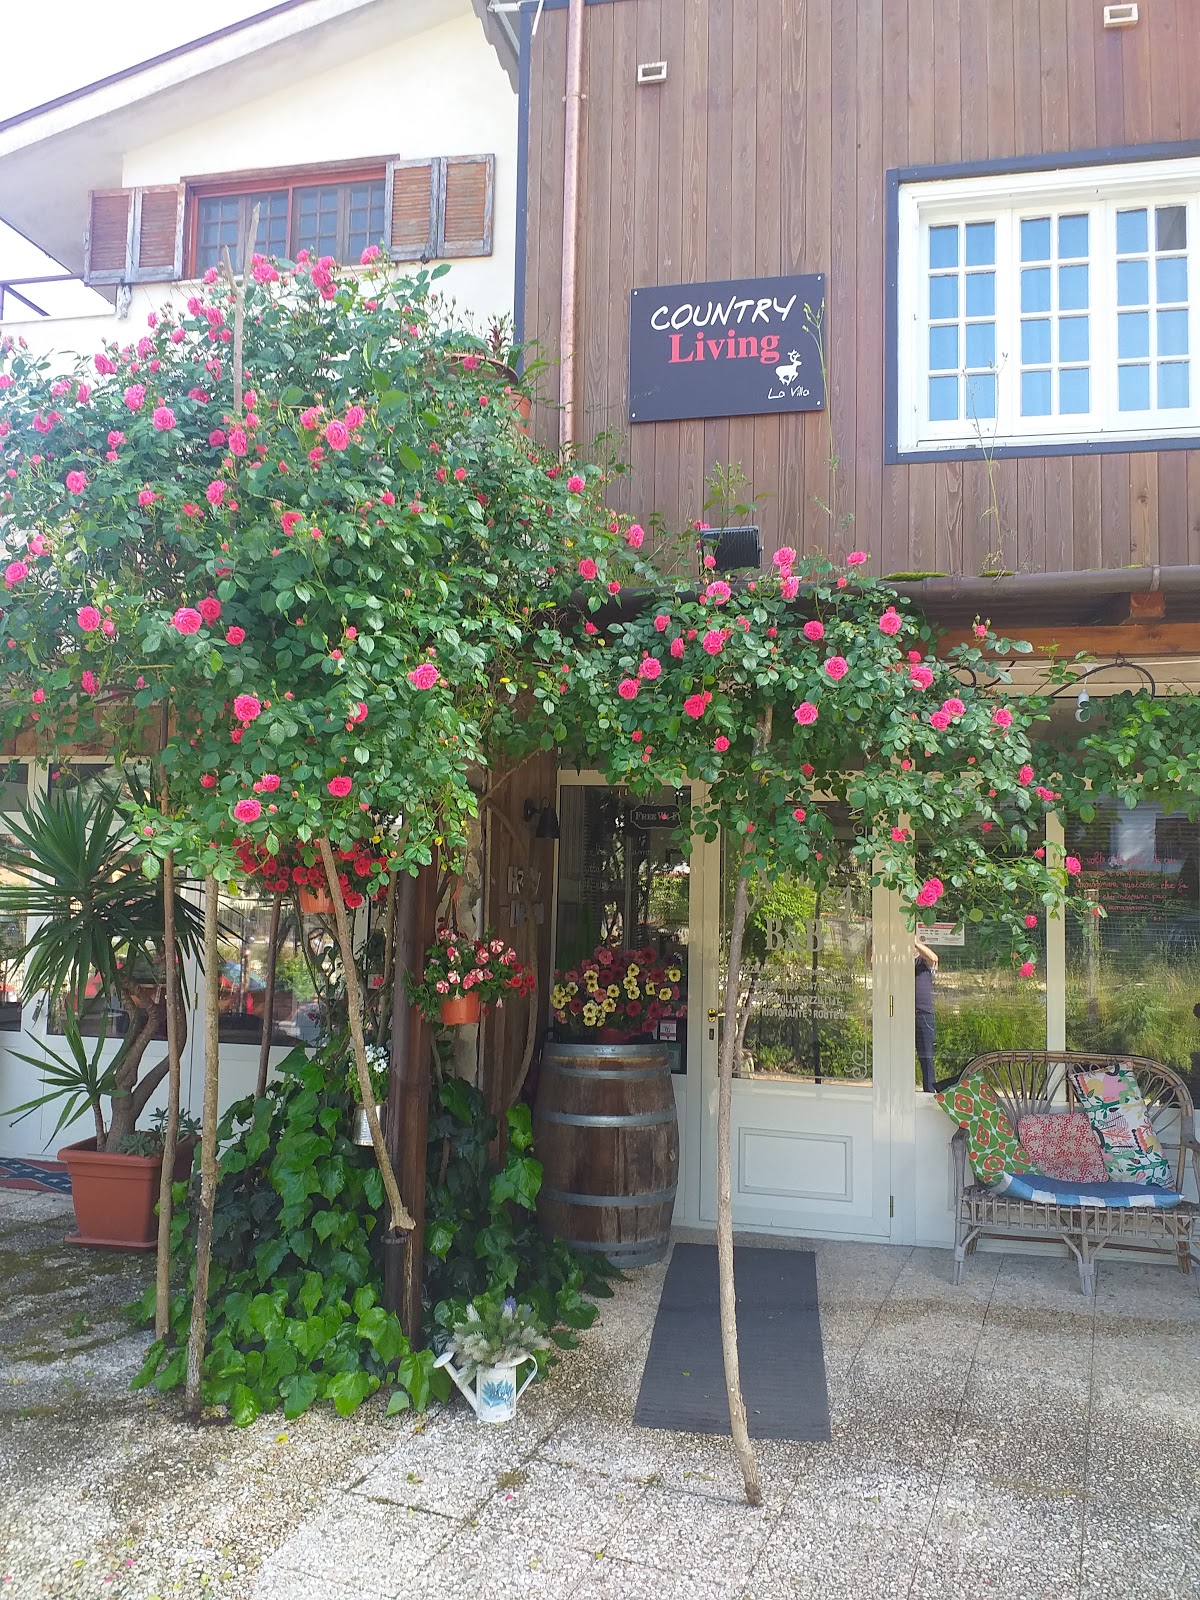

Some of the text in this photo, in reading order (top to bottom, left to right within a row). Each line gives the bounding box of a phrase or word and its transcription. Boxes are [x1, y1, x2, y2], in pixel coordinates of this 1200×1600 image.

[650, 295, 797, 331] COUNTRY
[668, 329, 780, 364] Living
[767, 385, 810, 400] La Villa
[765, 917, 825, 952] B&B
[761, 1007, 808, 1018] RISTORANTE
[813, 1009, 839, 1020] ROUTE
